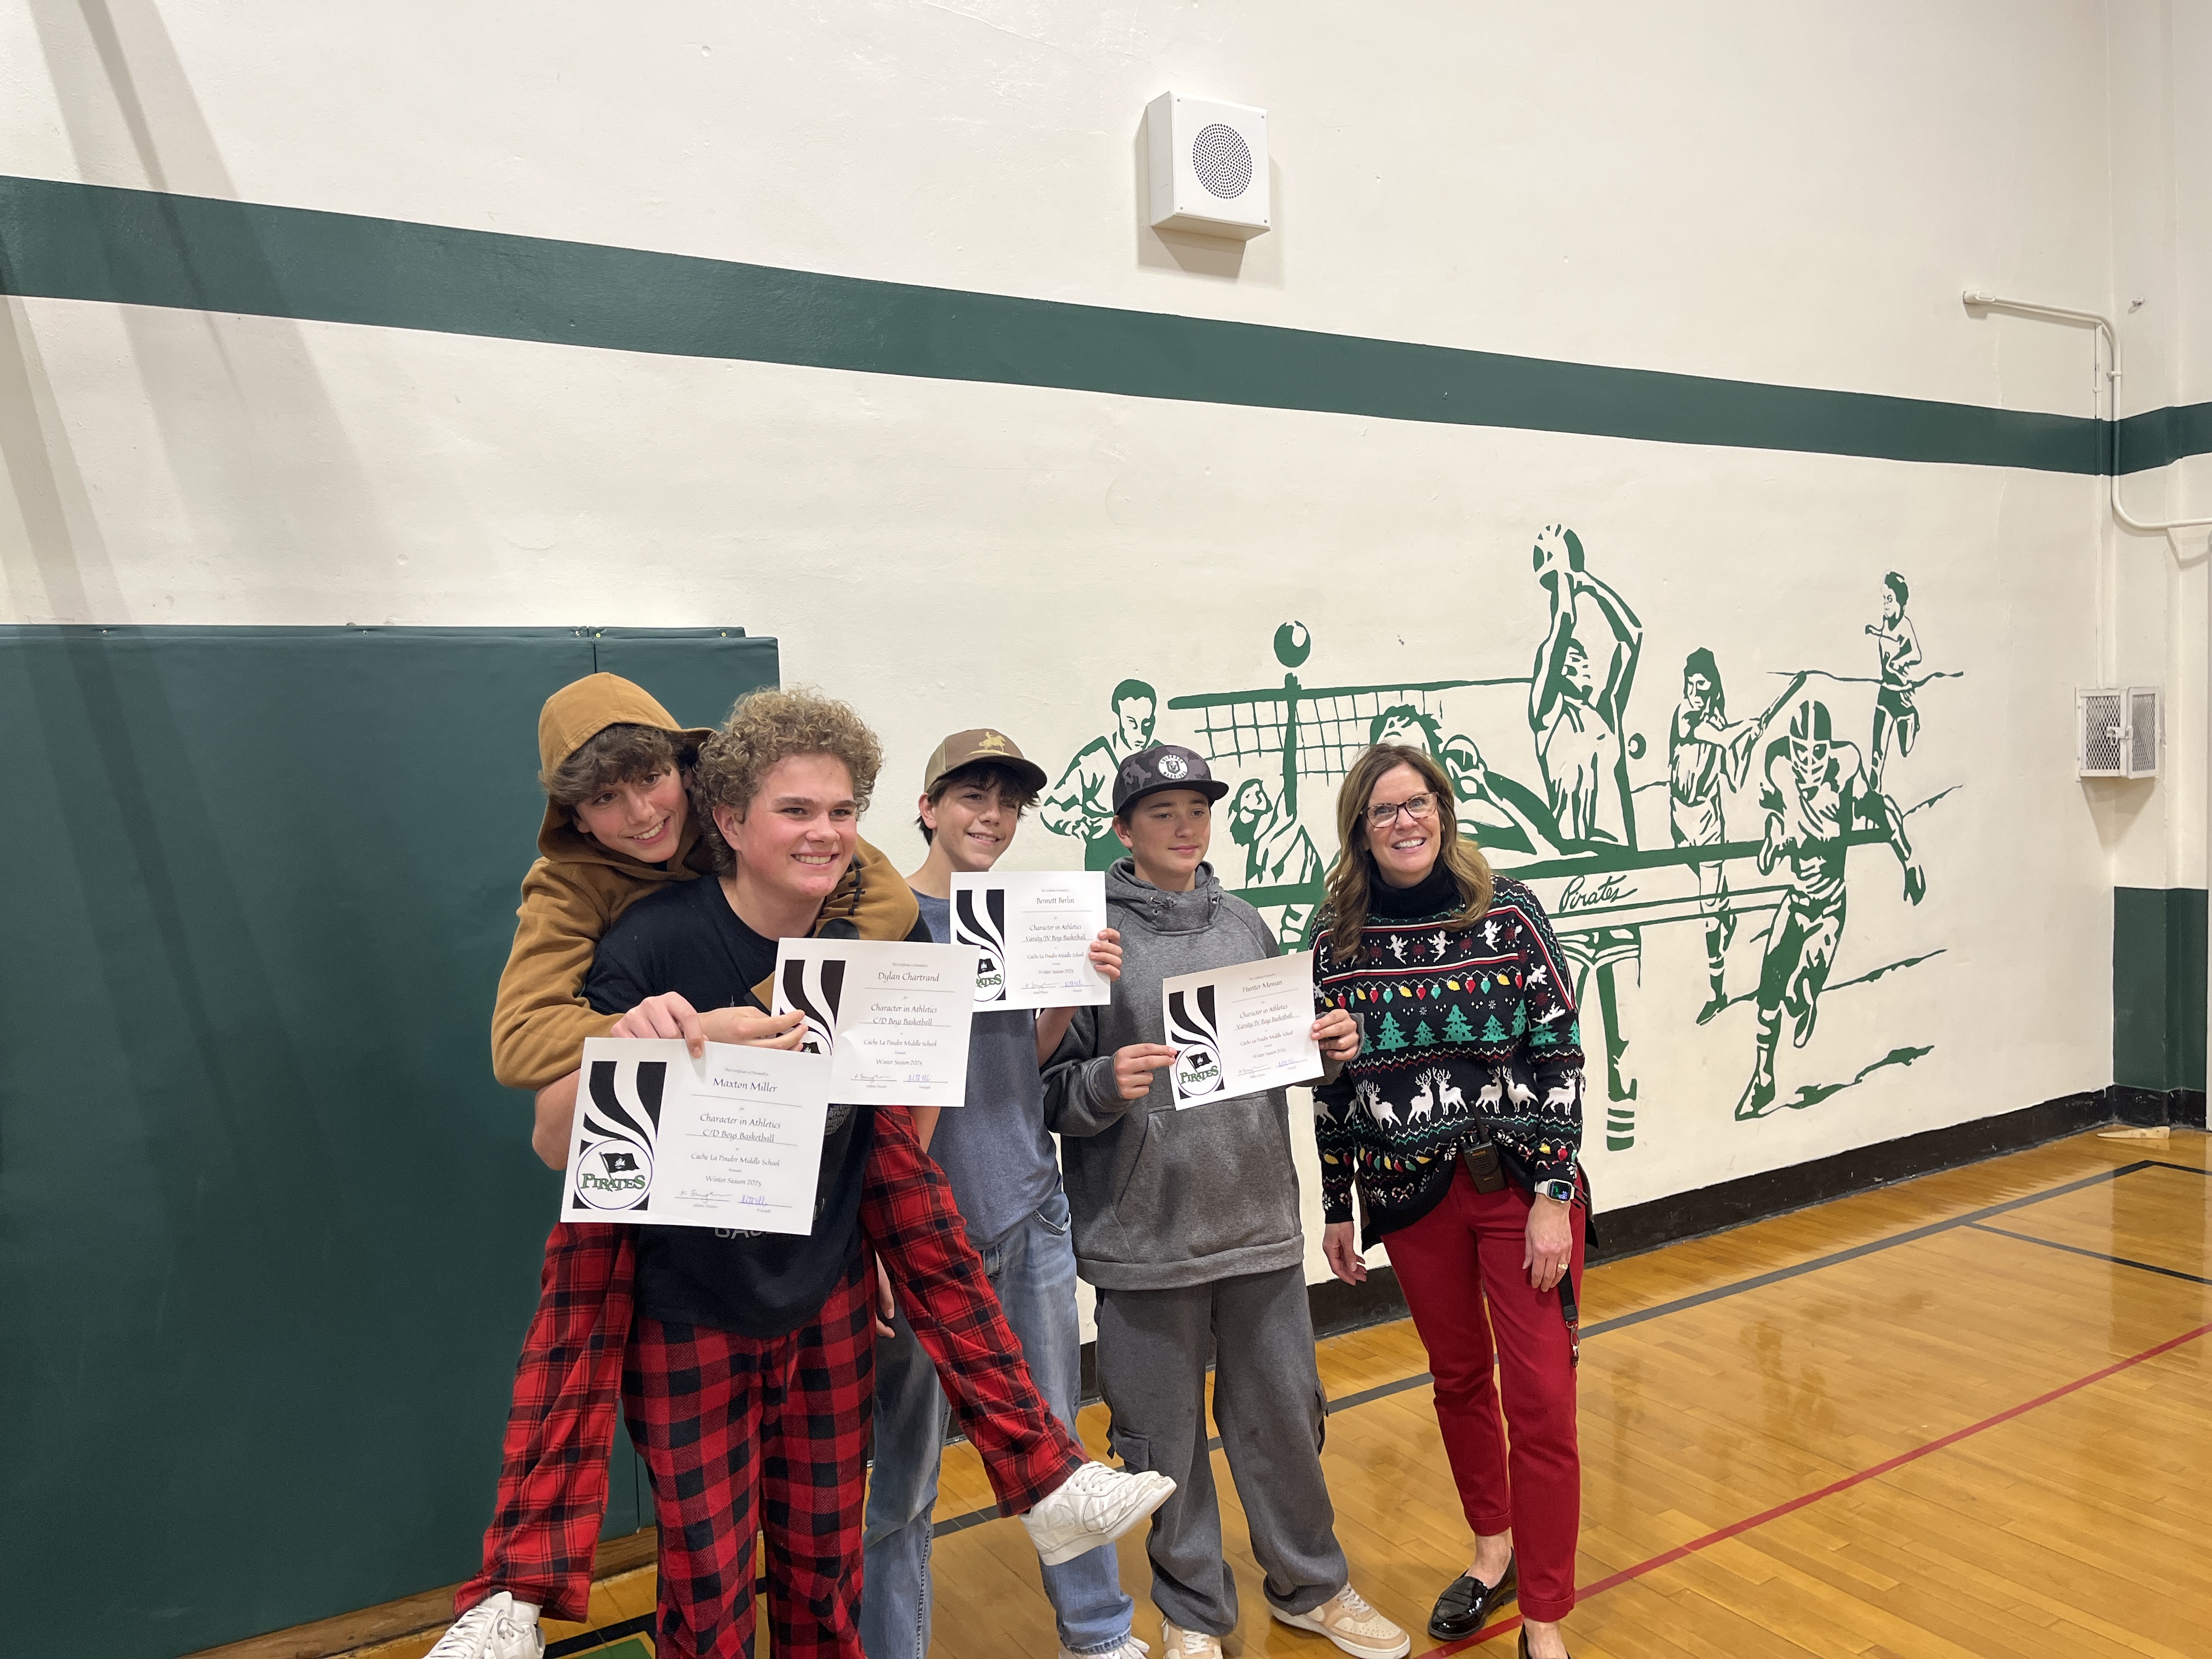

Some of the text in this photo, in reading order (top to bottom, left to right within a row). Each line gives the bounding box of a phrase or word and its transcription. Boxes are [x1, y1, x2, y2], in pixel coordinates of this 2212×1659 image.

[1559, 874, 1638, 913] Pirates
[878, 970, 940, 983] Dylan Chartrand
[975, 974, 1002, 988] RATES
[1262, 980, 1283, 989] Mowan
[871, 1003, 902, 1012] Character
[911, 1005, 938, 1013] Athletics
[1239, 1011, 1262, 1019] Character
[1269, 1004, 1288, 1012] Athletics
[888, 1018, 902, 1027] Boys
[903, 1018, 933, 1026] Basketball
[1272, 1012, 1293, 1023] Basketball
[1180, 1065, 1218, 1084] PIRATES
[714, 1077, 777, 1093] Maxton Miller
[700, 1113, 781, 1129] Character in Athletics
[721, 1131, 737, 1142] Boys
[740, 1132, 775, 1142] Basketball
[580, 1173, 646, 1192] PIRATES
